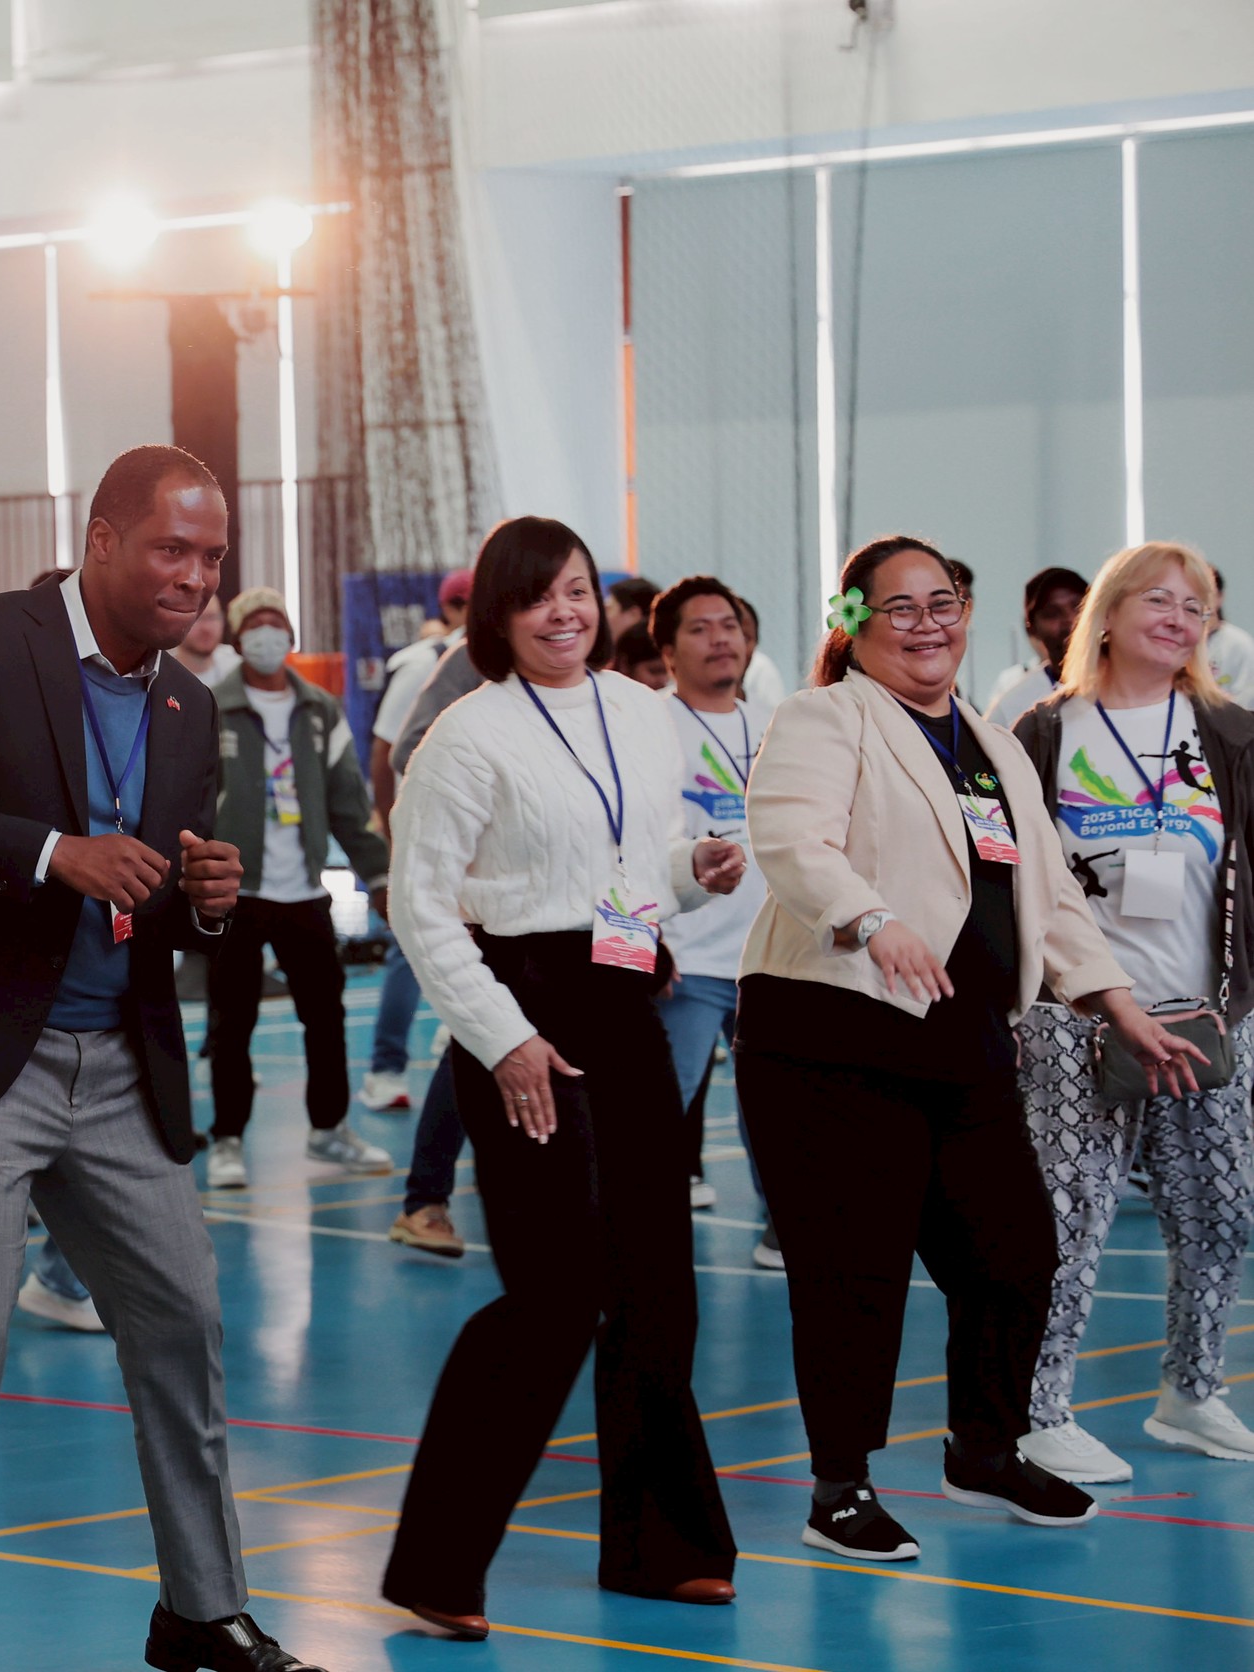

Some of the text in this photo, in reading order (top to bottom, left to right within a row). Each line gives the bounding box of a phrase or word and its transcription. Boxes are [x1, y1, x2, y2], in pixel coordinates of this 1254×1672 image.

[1081, 810, 1116, 825] 2025
[1119, 807, 1155, 819] TICA
[1080, 820, 1136, 836] Beyond
[832, 1507, 858, 1522] FILA
